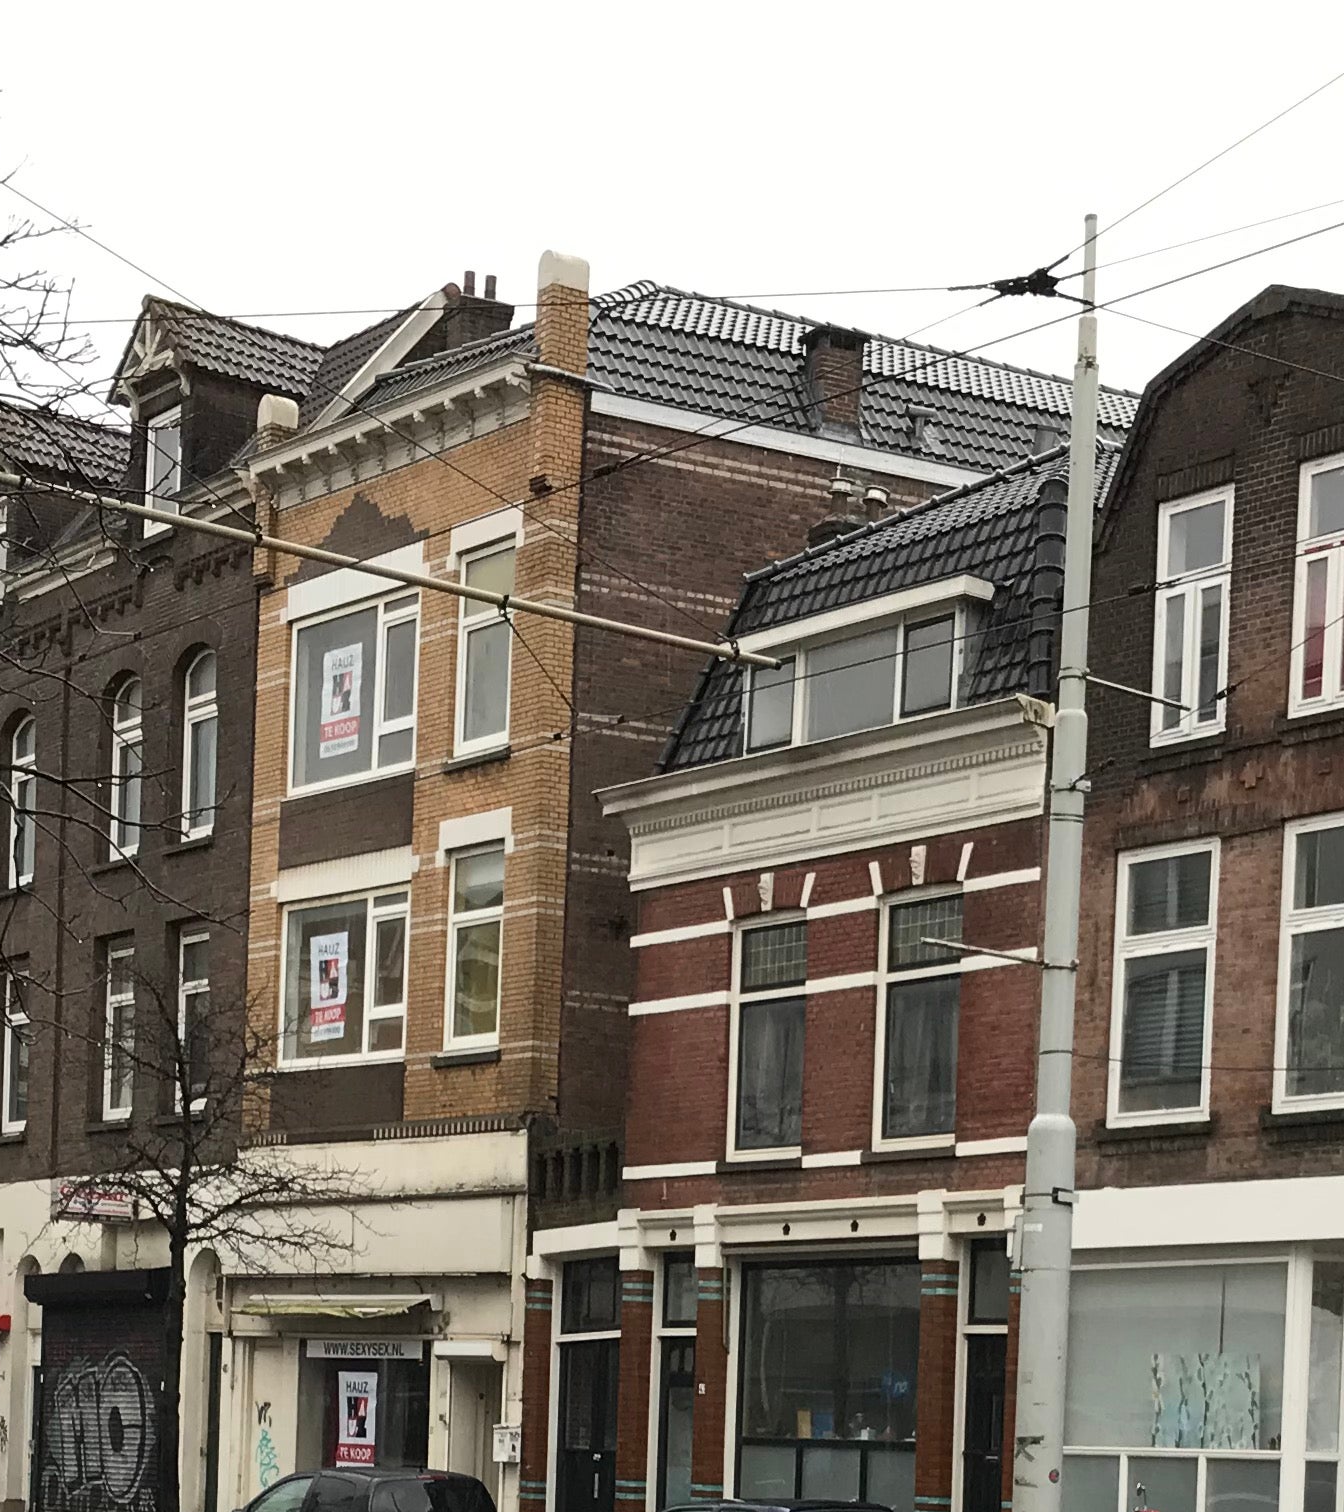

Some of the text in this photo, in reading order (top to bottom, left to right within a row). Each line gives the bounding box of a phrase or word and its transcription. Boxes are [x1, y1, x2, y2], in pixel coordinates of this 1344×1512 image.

[332, 655, 354, 670] HAUZ
[324, 721, 356, 738] TE KOOP
[318, 943, 340, 956] HAUZ
[323, 1342, 404, 1357] WWW.SEXYSEX.NL
[346, 1381, 368, 1393] HAUZ
[340, 1447, 371, 1460] TE KOOP
